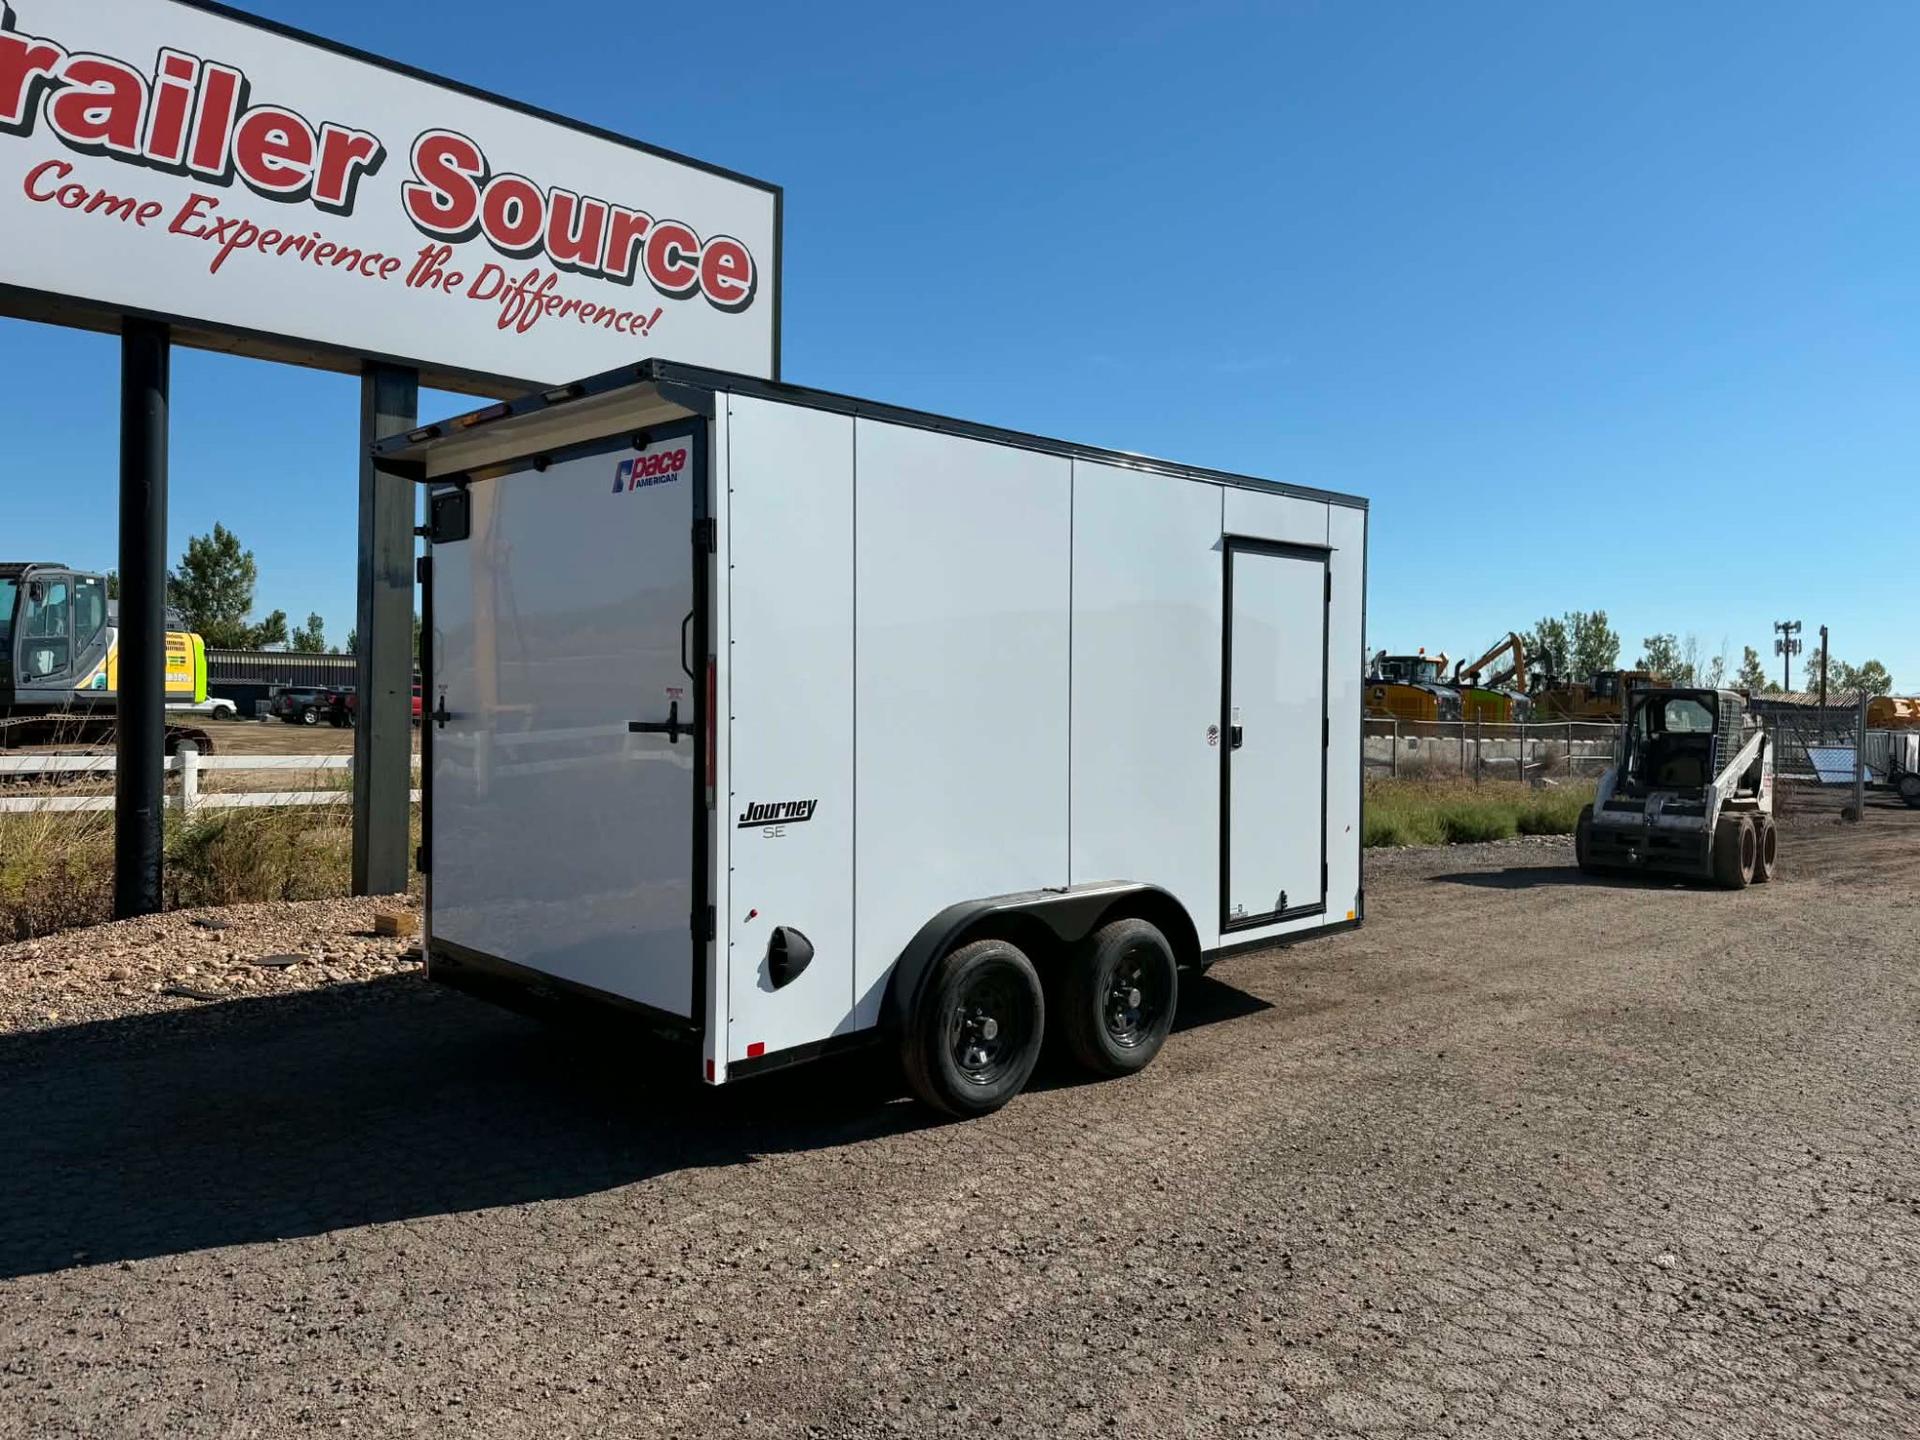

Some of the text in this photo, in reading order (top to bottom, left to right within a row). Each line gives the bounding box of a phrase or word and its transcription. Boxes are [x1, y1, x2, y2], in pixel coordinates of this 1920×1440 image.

[0, 28, 756, 310] railer Source
[23, 159, 662, 337] Come Experience the Difference!
[628, 448, 687, 491] pace
[636, 473, 678, 488] AMERICAN
[738, 799, 818, 828] Journey
[763, 825, 786, 838] SE
